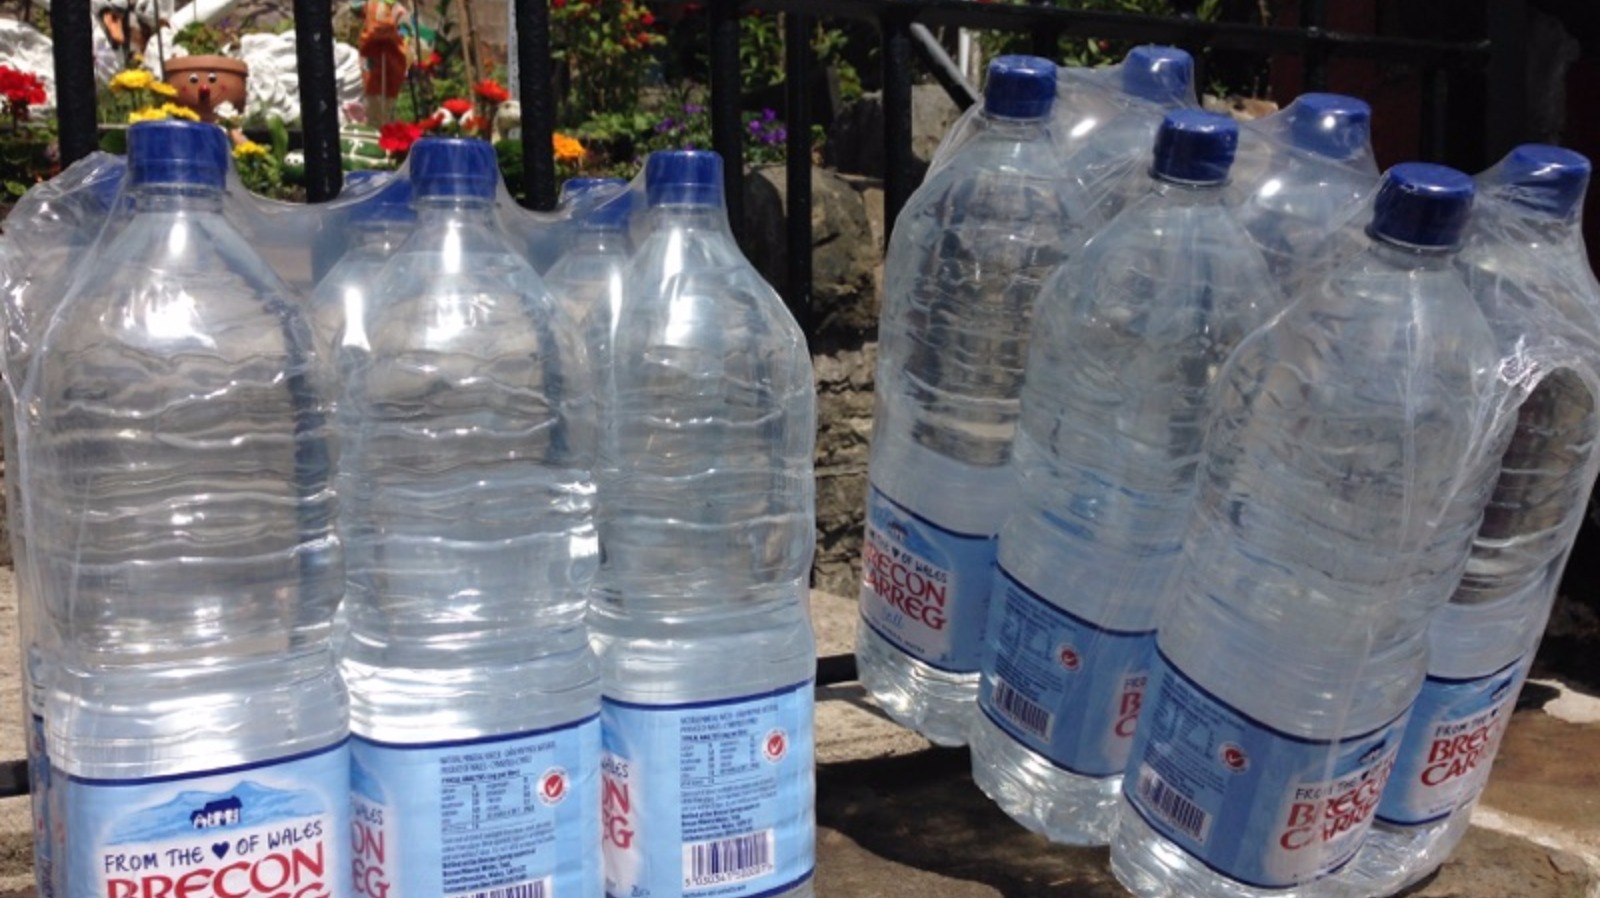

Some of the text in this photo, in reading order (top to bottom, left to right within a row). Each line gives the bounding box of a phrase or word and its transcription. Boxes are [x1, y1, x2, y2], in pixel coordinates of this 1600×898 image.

[865, 541, 946, 608] RECON
[867, 570, 947, 631] ARREG
[104, 820, 323, 874] FROM THE OF WALES
[107, 841, 324, 898] BRECON
